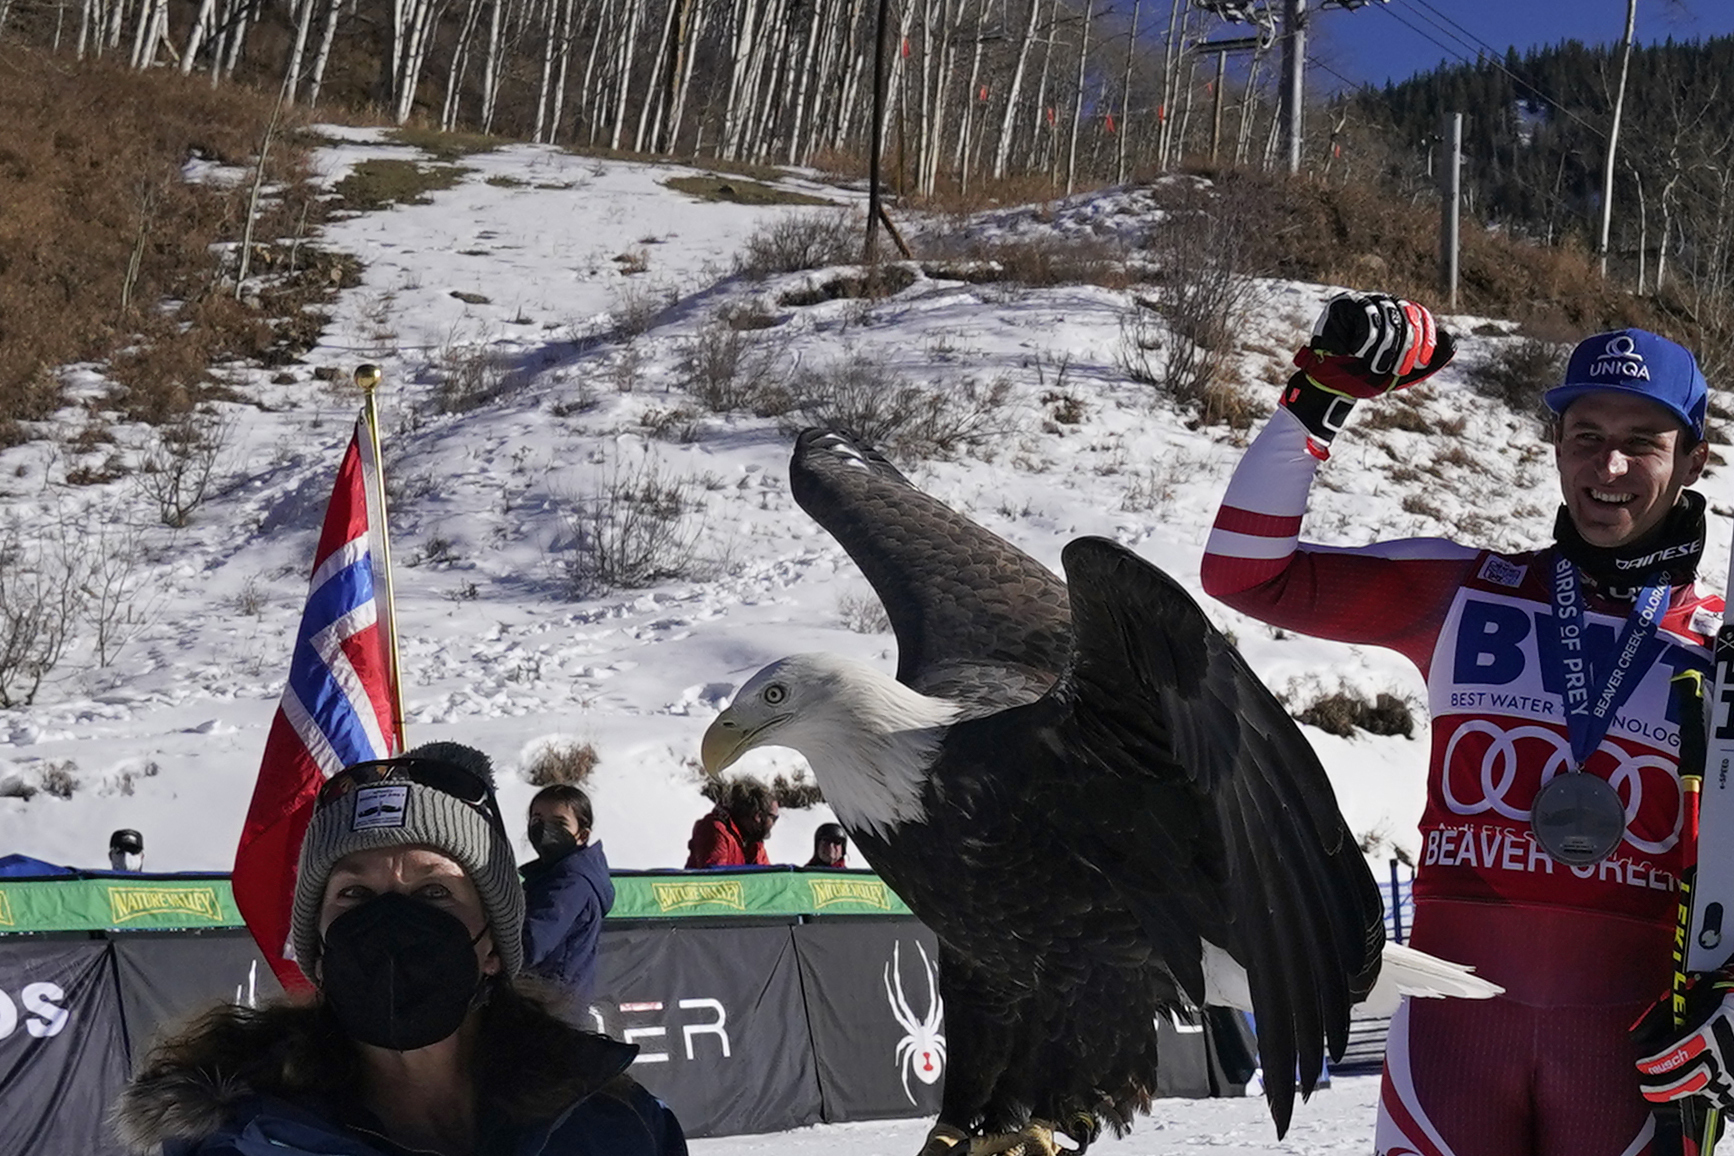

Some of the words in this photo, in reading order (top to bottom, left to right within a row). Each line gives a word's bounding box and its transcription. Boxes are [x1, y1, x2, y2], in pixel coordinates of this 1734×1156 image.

[1589, 359, 1650, 383] UNIQA
[1555, 558, 1577, 619] BIRDS
[1560, 627, 1580, 656] OF
[1593, 669, 1625, 718] BEAVER
[1618, 629, 1648, 669] CREEK,
[1638, 570, 1672, 627] COLORADO
[1450, 692, 1487, 707] BEST
[1490, 693, 1554, 715] WATER
[1563, 658, 1590, 717] PREY
[1425, 828, 1553, 874] BEAVER
[114, 892, 168, 917] NATURE
[165, 892, 213, 915] VALLEY
